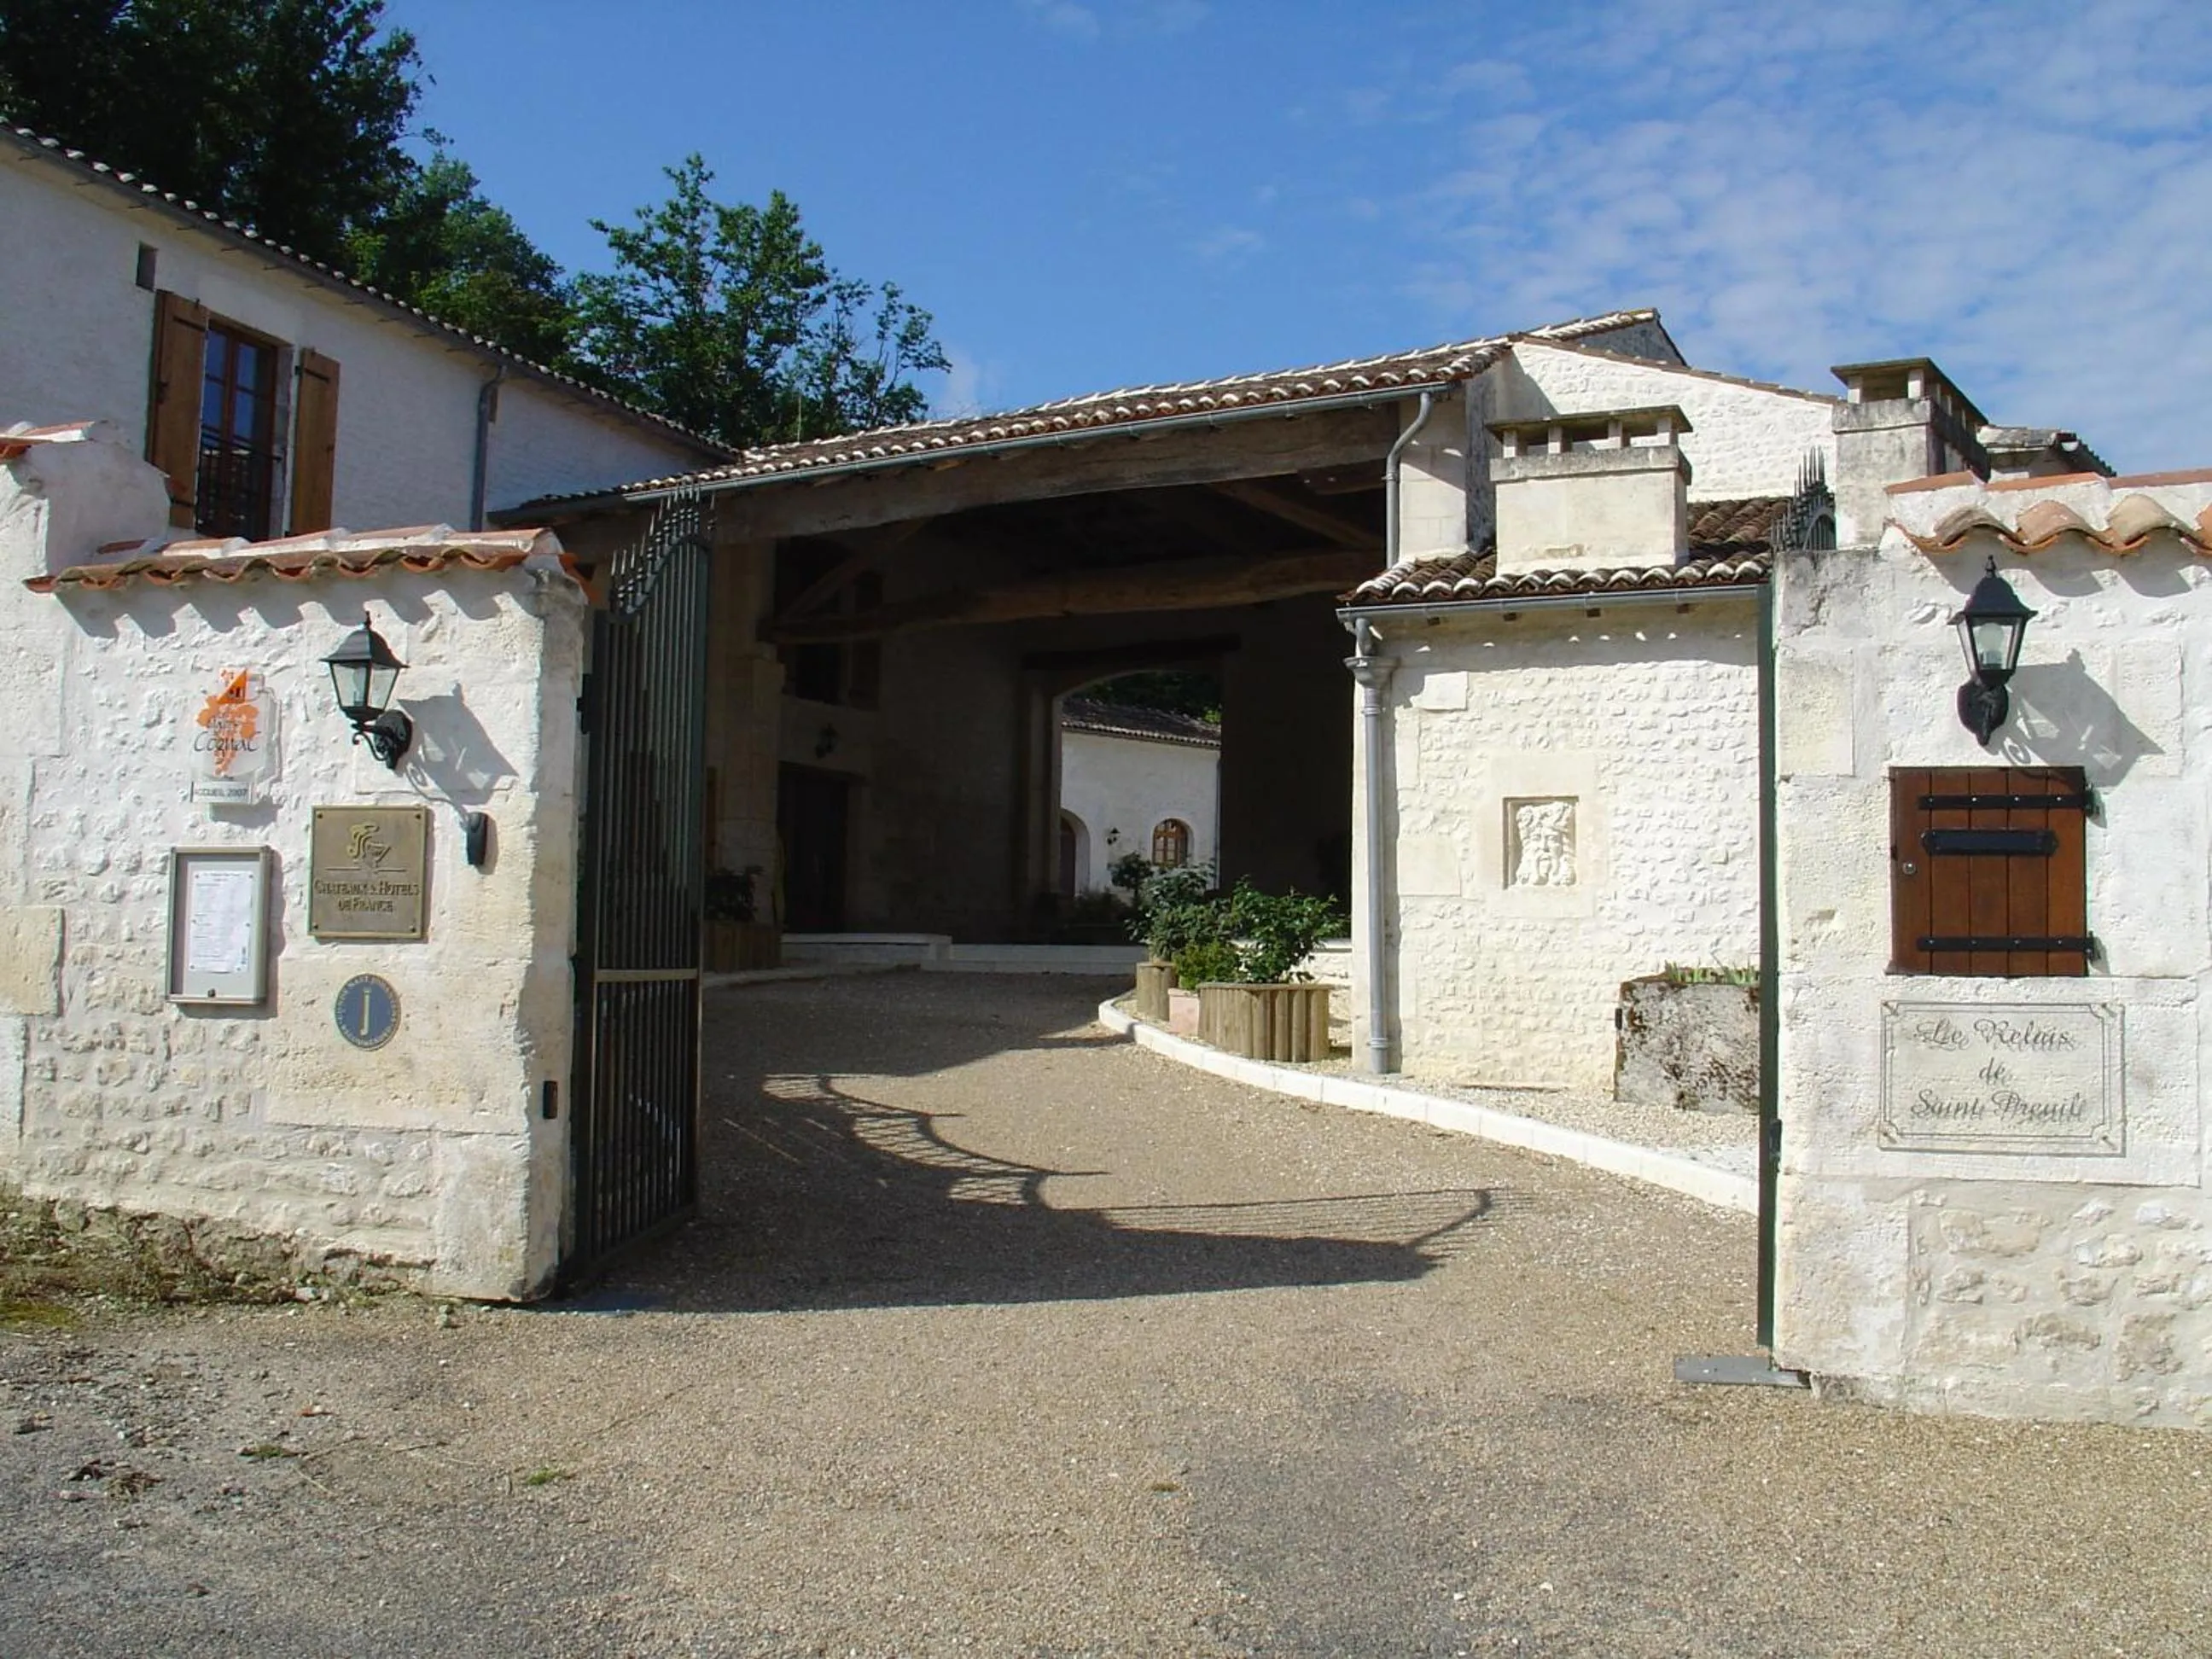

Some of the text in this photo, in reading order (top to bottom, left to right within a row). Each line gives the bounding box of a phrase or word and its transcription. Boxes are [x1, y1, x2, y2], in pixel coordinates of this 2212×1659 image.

[227, 788, 247, 797] 2007
[1912, 1017, 2075, 1049] Le Relais
[1978, 1057, 2007, 1081] de
[1911, 1088, 1983, 1118] Saint
